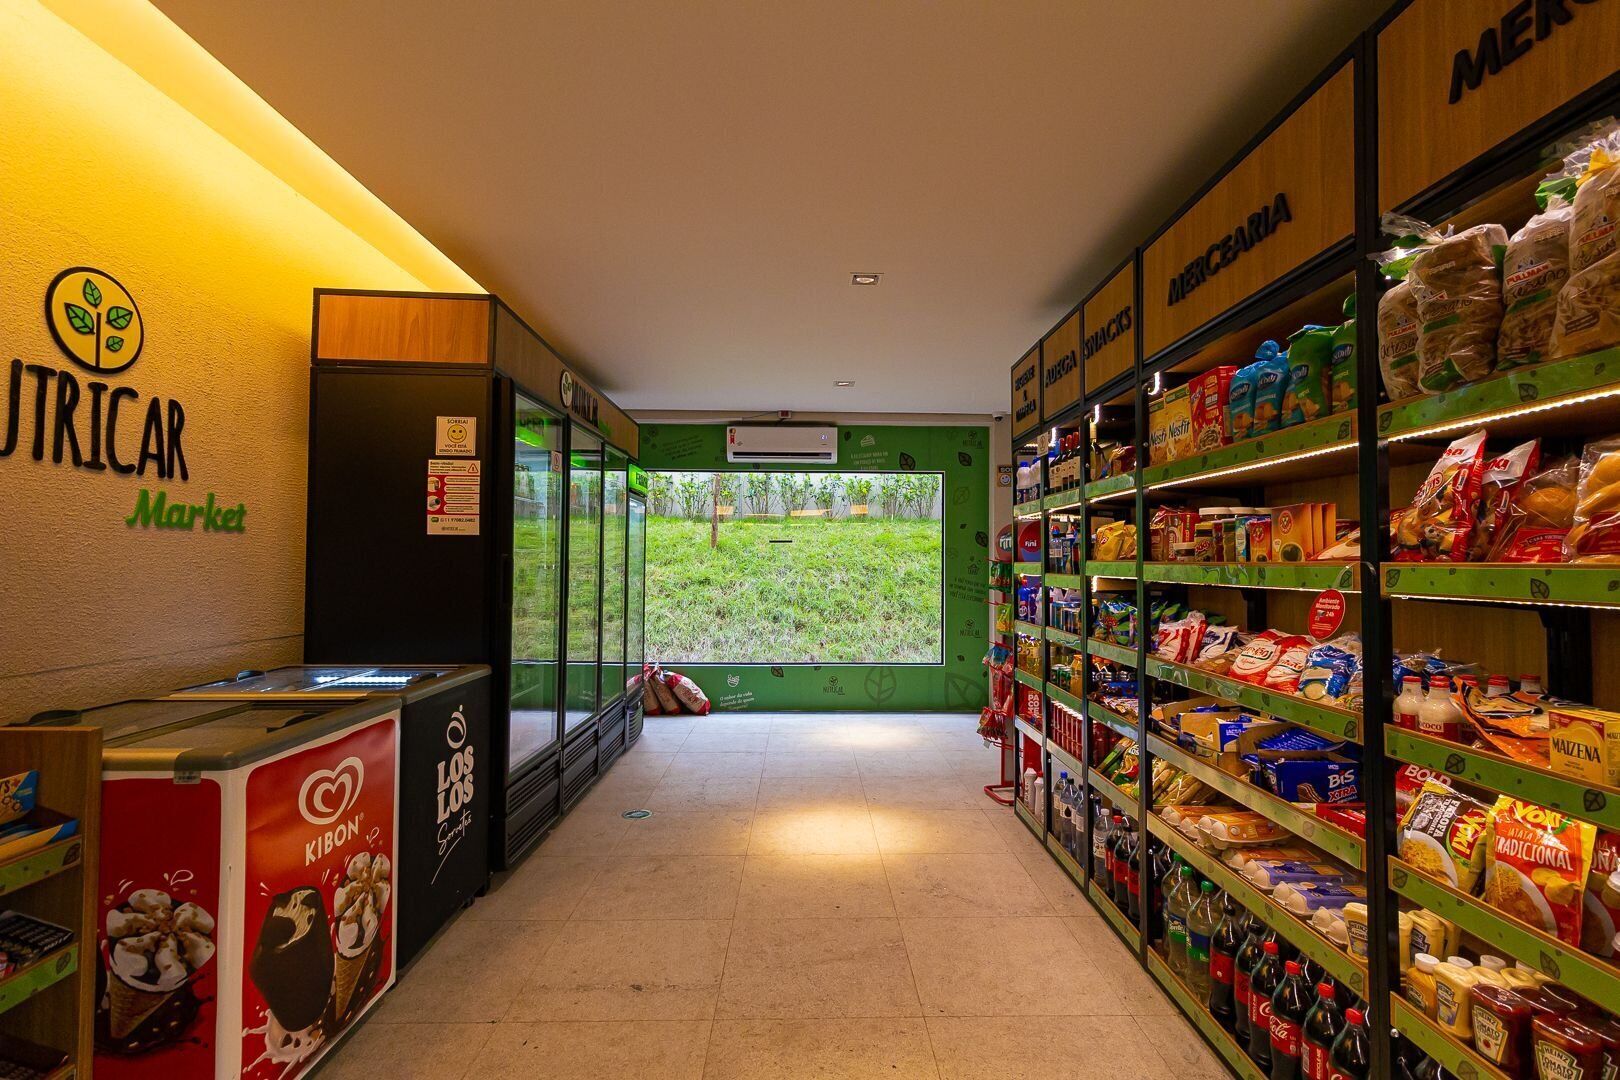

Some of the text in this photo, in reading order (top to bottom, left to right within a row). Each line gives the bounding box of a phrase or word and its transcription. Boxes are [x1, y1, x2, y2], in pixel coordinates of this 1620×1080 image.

[1168, 193, 1292, 306] MERCEARIA
[1083, 306, 1131, 360] SNACKS
[1045, 350, 1077, 388] ADEGA
[1168, 417, 1190, 439] Nesfit
[125, 488, 247, 532] Market
[1552, 736, 1601, 764] MAIZENA
[437, 745, 474, 793] LOS
[437, 773, 474, 824] LOS
[1328, 785, 1358, 803] XTRA
[1515, 801, 1561, 828] YOKI
[305, 816, 359, 866] KIBON
[1495, 835, 1574, 871] TRADICIONAL
[1541, 1053, 1574, 1077] TOMATO
[1544, 1046, 1568, 1064] HEINZ
